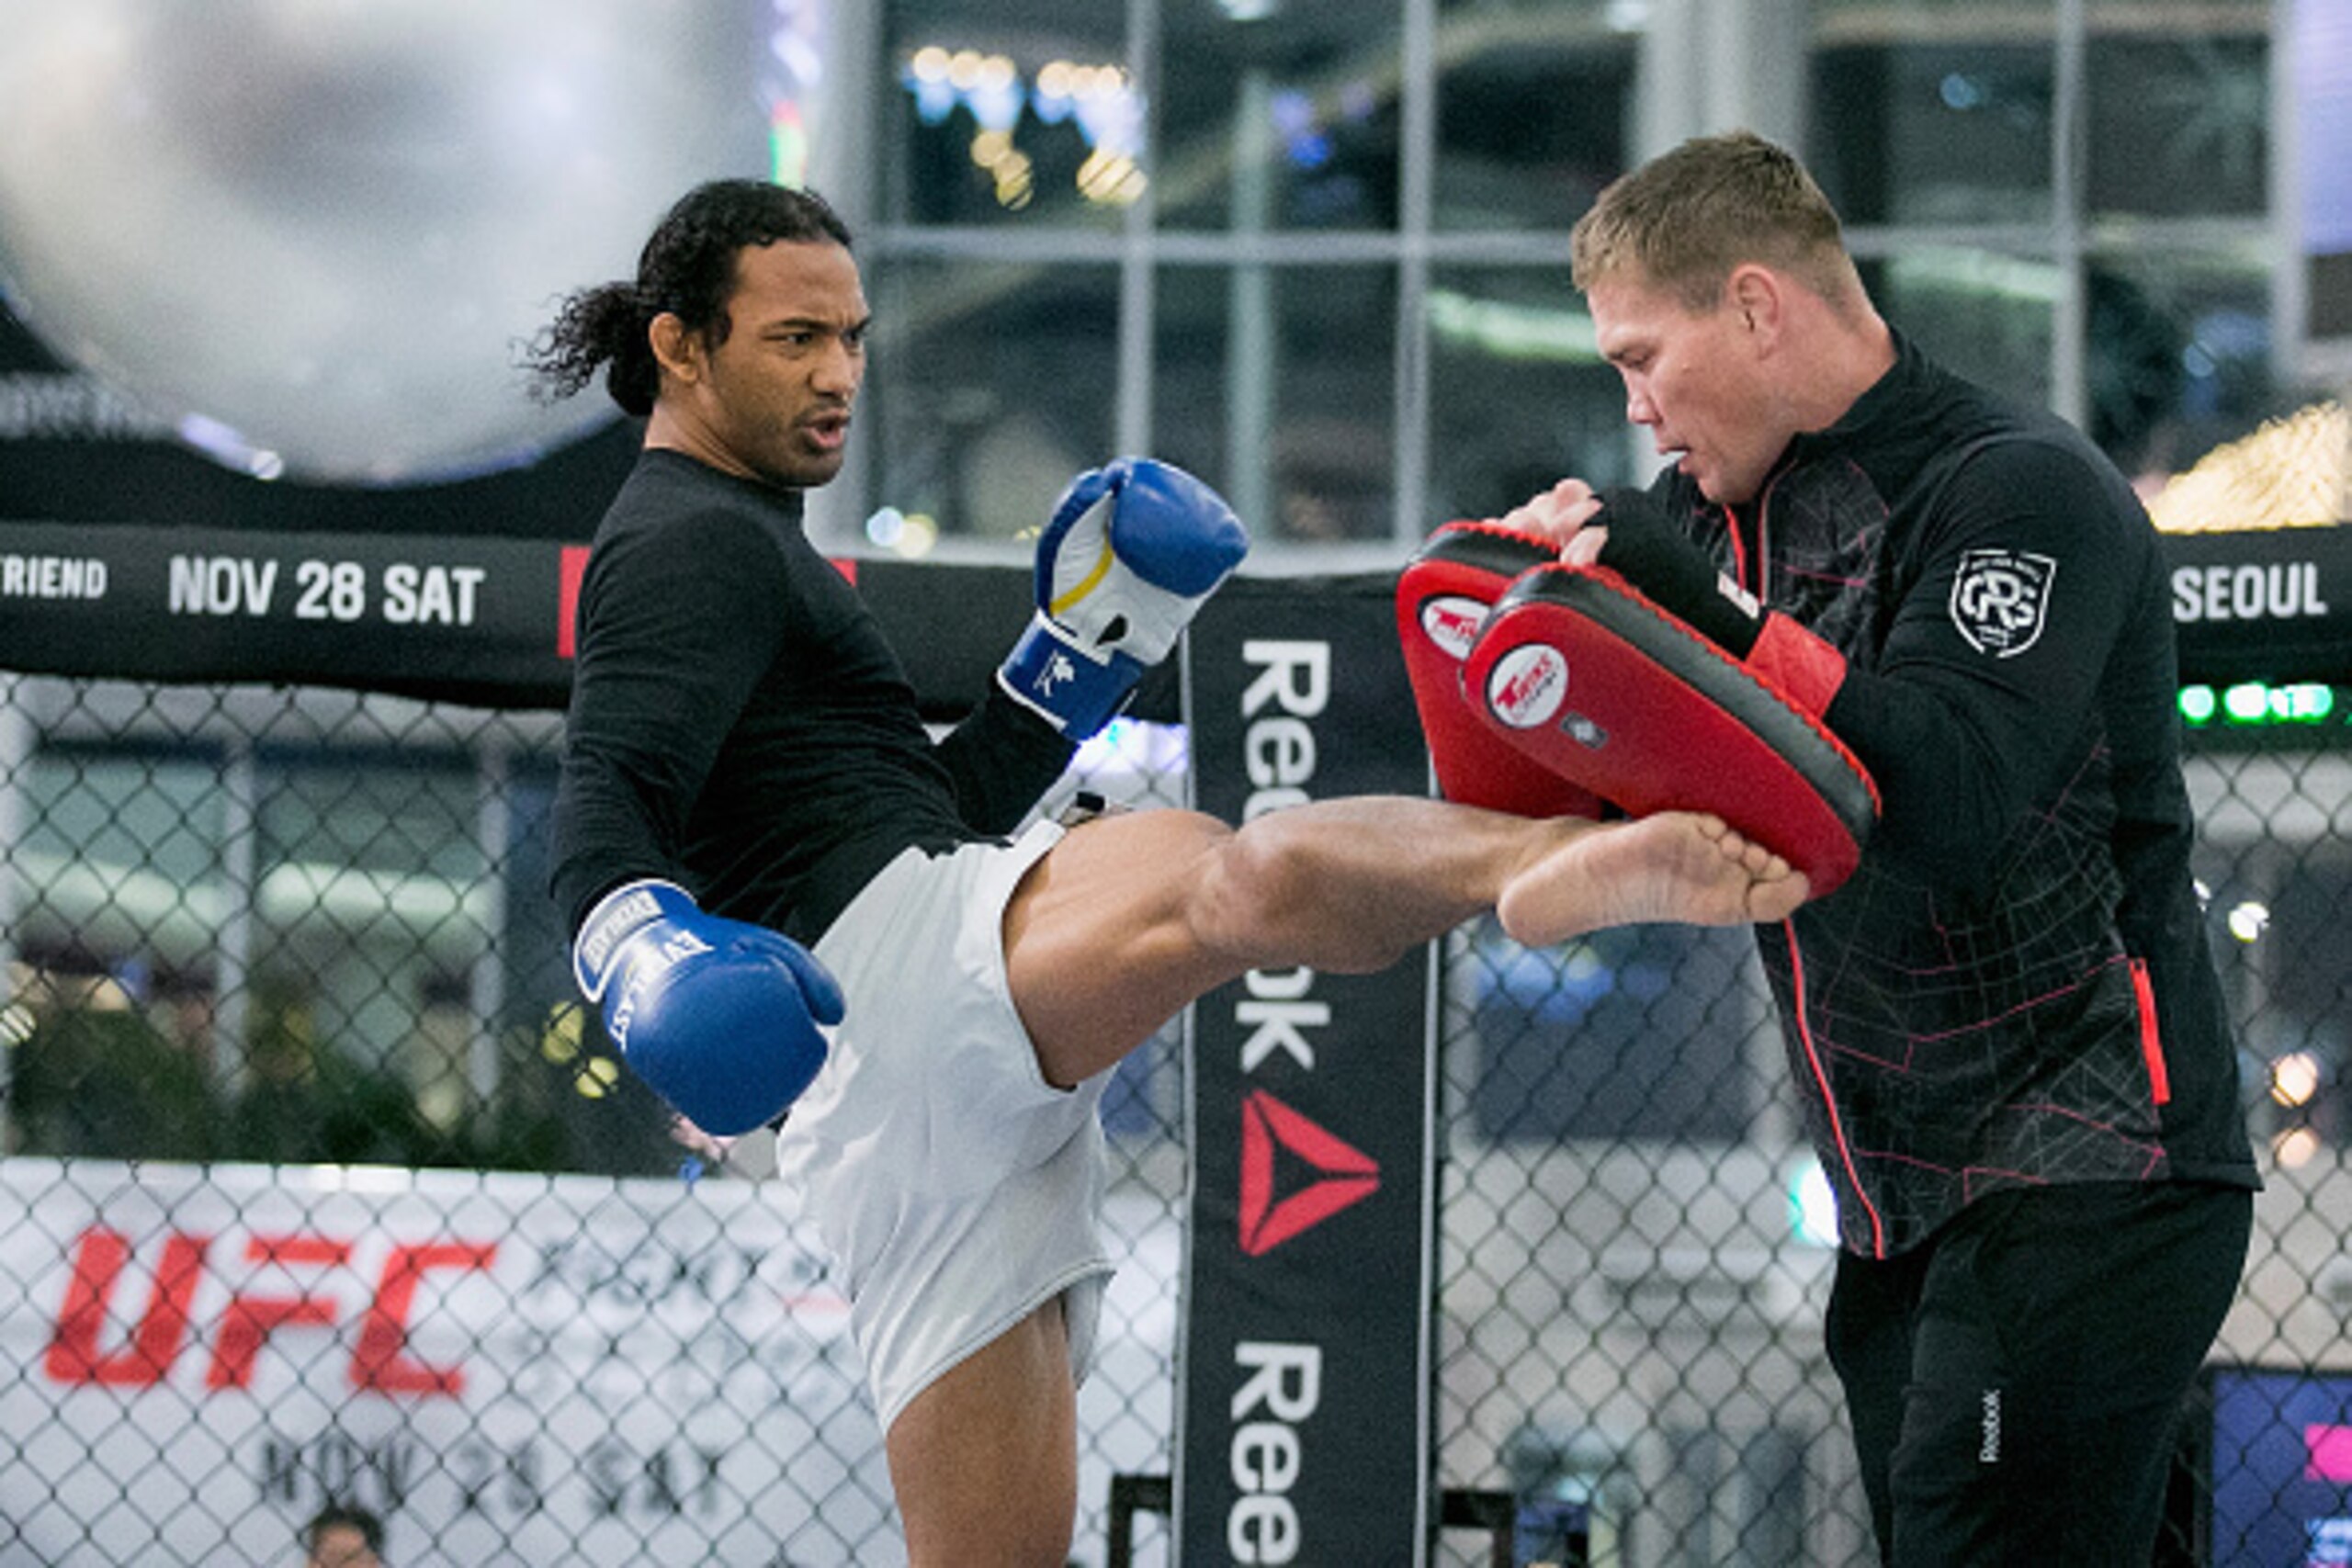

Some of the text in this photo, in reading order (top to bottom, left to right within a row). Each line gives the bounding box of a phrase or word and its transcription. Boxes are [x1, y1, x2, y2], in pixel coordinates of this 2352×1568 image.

[0, 554, 108, 599] RIEND
[170, 556, 486, 625] NOV 28 SAT
[2171, 562, 2328, 622] SEOUL
[1235, 640, 1331, 1073] Rek
[44, 1224, 497, 1398] UFC
[1979, 1389, 2001, 1462] Reebok
